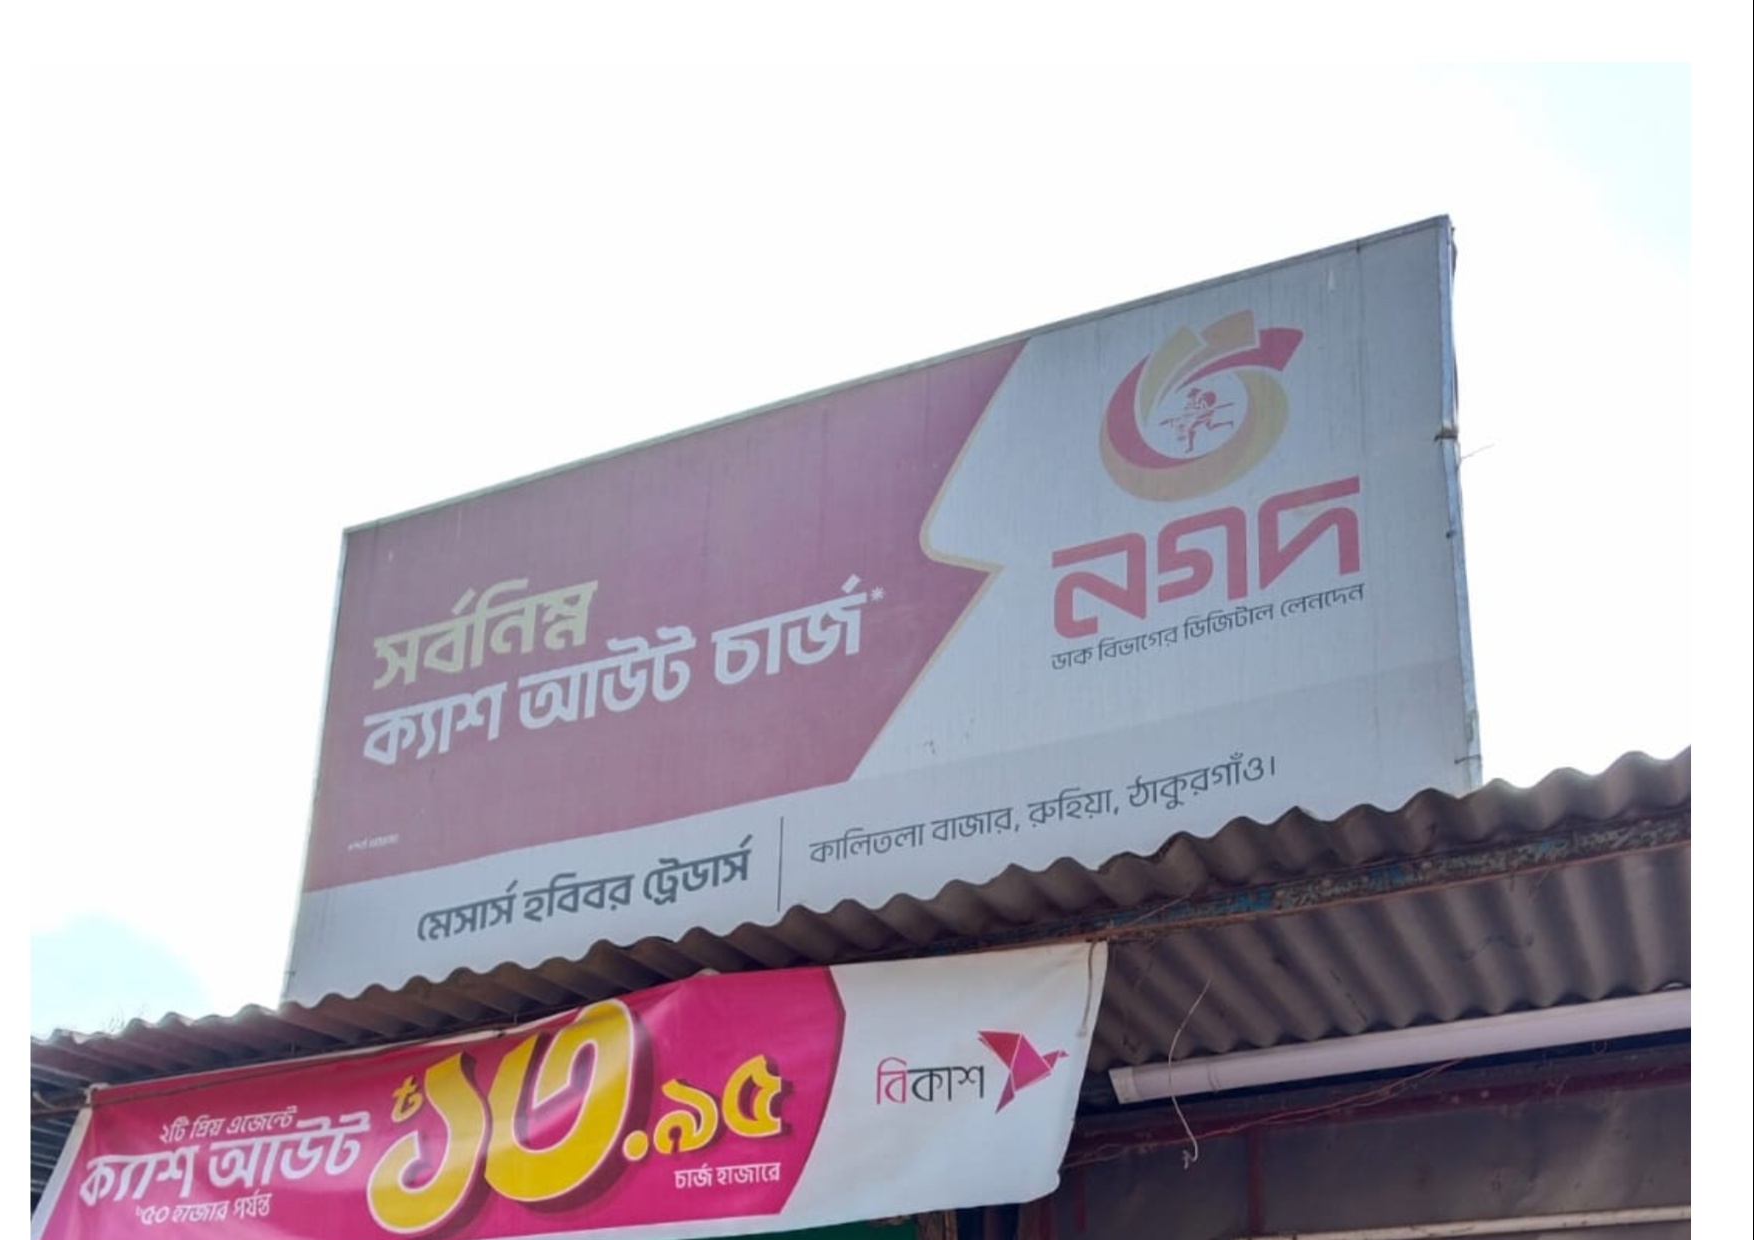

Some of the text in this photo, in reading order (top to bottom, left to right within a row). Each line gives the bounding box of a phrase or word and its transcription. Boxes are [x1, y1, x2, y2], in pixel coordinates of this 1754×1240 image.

[1051, 476, 1361, 639] নগদ
[373, 578, 598, 690] সর্বনিম্ন
[1050, 581, 1365, 671] ডাক বিভাগের ডিজিটাল লেনদেন
[362, 681, 507, 766] ক্যাশ
[517, 626, 697, 731] আউট
[808, 821, 927, 866] কালিতলা
[931, 805, 1021, 842] বাজার,
[417, 833, 754, 943] মেসার্স হবিবর ট্রেডার্স
[160, 1120, 189, 1144] ২টি
[226, 1105, 299, 1136] এজেন্টে
[877, 1056, 985, 1105] বিকাশ
[78, 1111, 372, 1207] ক্যাশ আউট
[673, 1160, 782, 1190] চার্জ হাজারে
[172, 1199, 229, 1225] হাজার
[233, 1189, 273, 1222] পর্যন্ত
